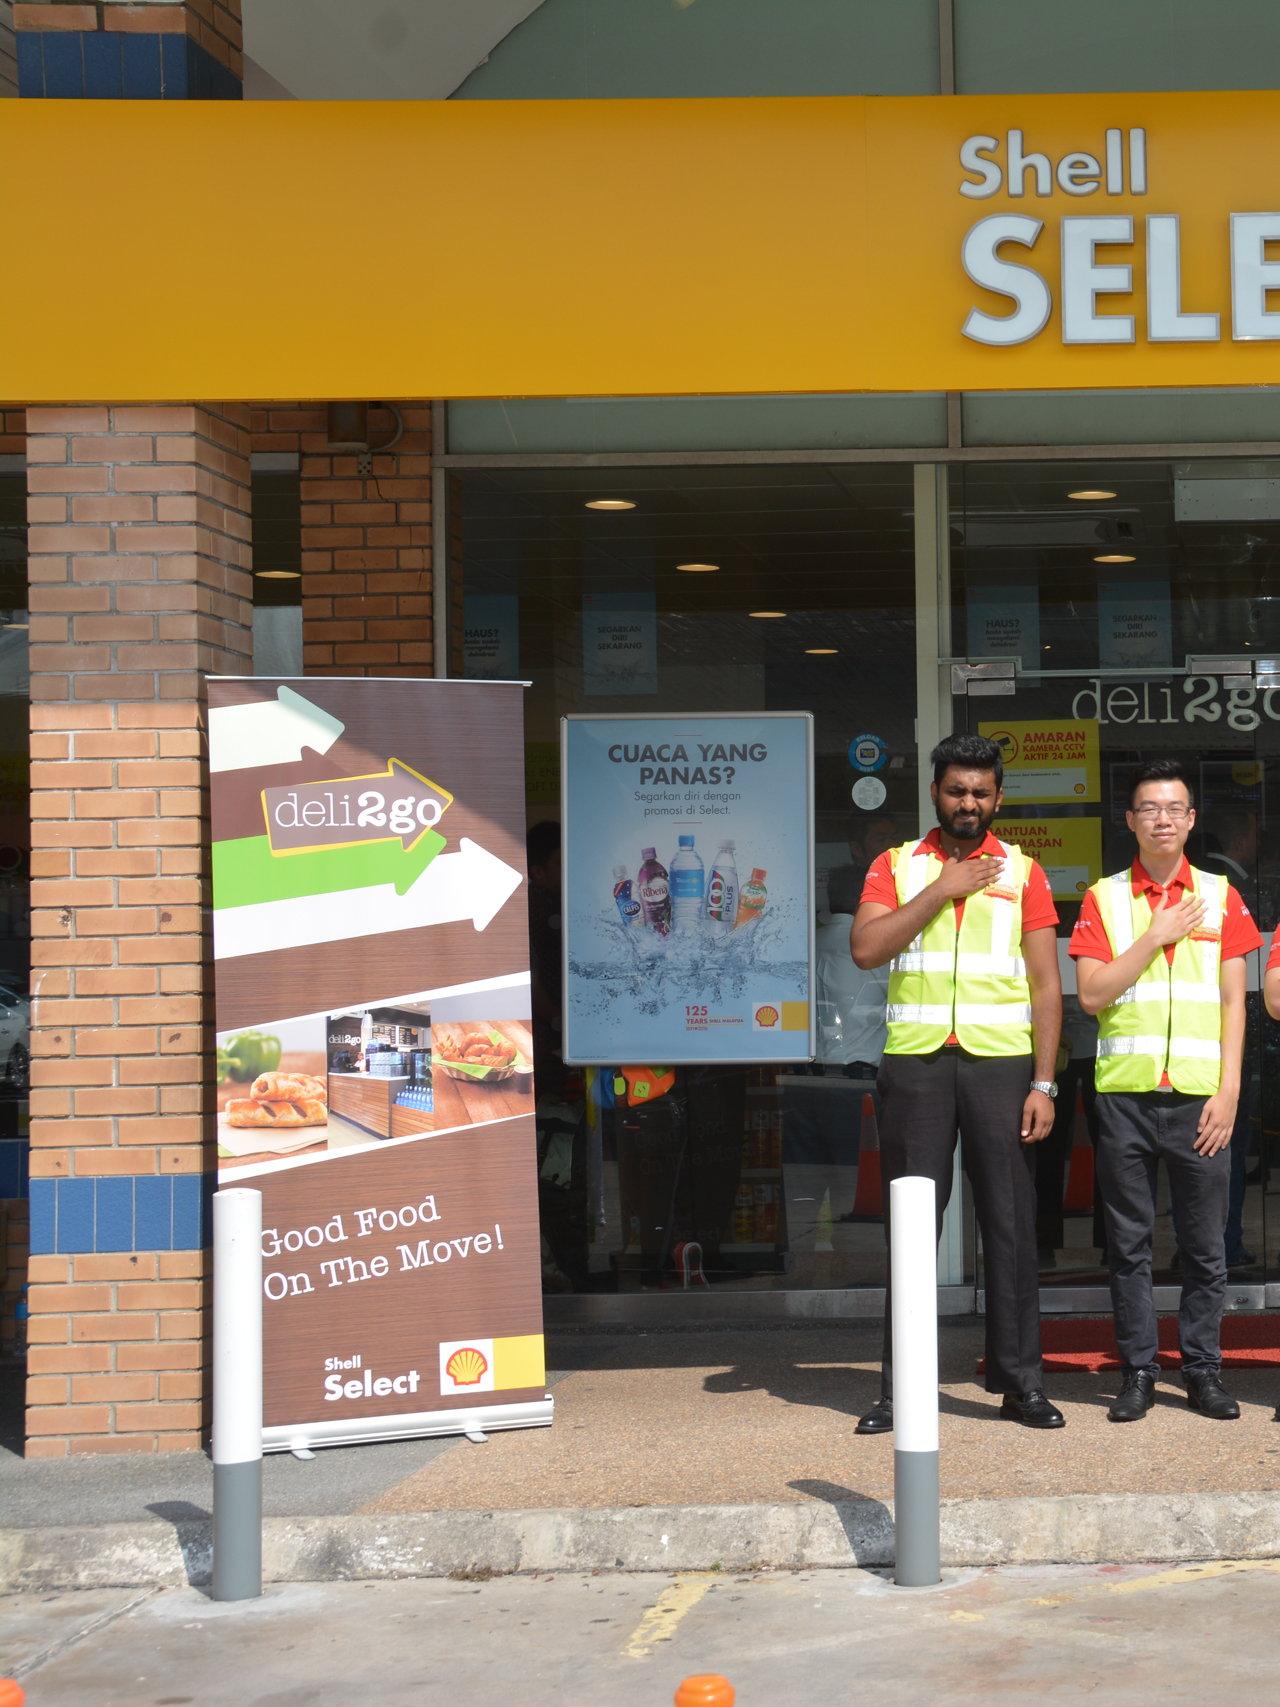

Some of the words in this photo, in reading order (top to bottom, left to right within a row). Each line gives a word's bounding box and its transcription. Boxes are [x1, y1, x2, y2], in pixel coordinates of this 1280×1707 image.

[958, 127, 1148, 199] Shell
[986, 619, 1020, 628] HAUS?
[1113, 614, 1157, 622] SEGARKAN
[464, 629, 499, 638] HAUS?
[597, 626, 642, 634] SEGARKAN
[1113, 631, 1157, 639] SEKARANG
[597, 642, 643, 650] SEKARANG
[1023, 731, 1086, 743] AMARAN
[608, 744, 688, 763] CUACA
[697, 744, 768, 763] YANG
[1023, 744, 1061, 752] KAMERA
[1063, 743, 1085, 751] CCTV
[1024, 753, 1049, 761] AKTIF
[1066, 752, 1086, 760] JAM
[639, 766, 736, 786] PANAS?
[634, 791, 681, 803] Segarkan
[684, 791, 700, 801] diri
[703, 790, 741, 803] dengan
[274, 790, 442, 835] deli2go
[644, 805, 683, 817] promosi
[686, 805, 696, 815] di
[699, 805, 731, 816] Select.
[642, 886, 668, 898] Ribena
[707, 878, 726, 912] 100
[725, 886, 733, 913] PLUS
[685, 1006, 708, 1016] 125
[328, 1033, 361, 1046] deli2go
[261, 1215, 348, 1258] Good
[354, 1195, 441, 1238] Food
[264, 1271, 315, 1301] On
[320, 1254, 389, 1289] The
[396, 1224, 504, 1272] Move!
[324, 1355, 362, 1371] Shell
[324, 1368, 420, 1402] Select
